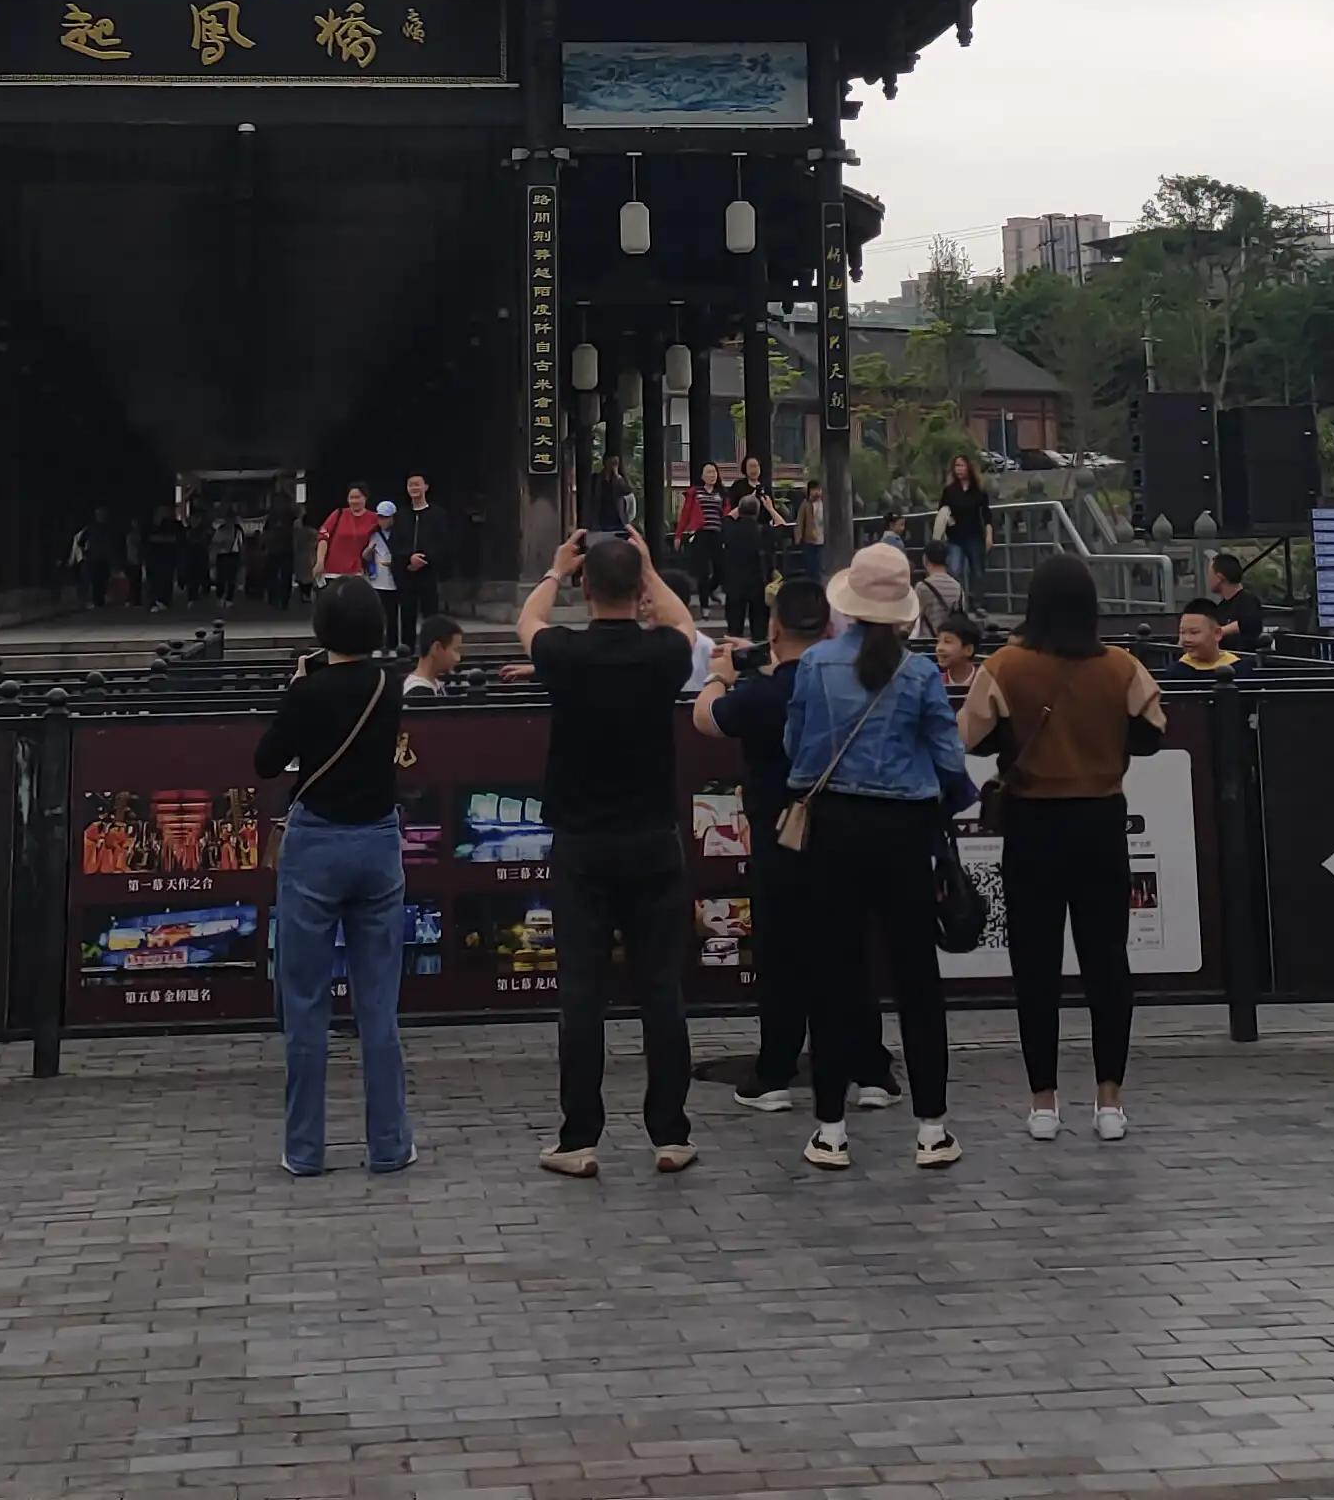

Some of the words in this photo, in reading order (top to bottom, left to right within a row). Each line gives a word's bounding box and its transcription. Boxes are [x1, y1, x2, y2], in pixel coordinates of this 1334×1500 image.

[496, 867, 532, 880] 第三幕
[535, 866, 550, 879] 文
[128, 878, 163, 892] 第一幕
[166, 876, 213, 891] 天作之合
[497, 978, 532, 991] 第七幕
[125, 990, 161, 1004] 第五幕
[164, 988, 212, 1003] 金榜题名
